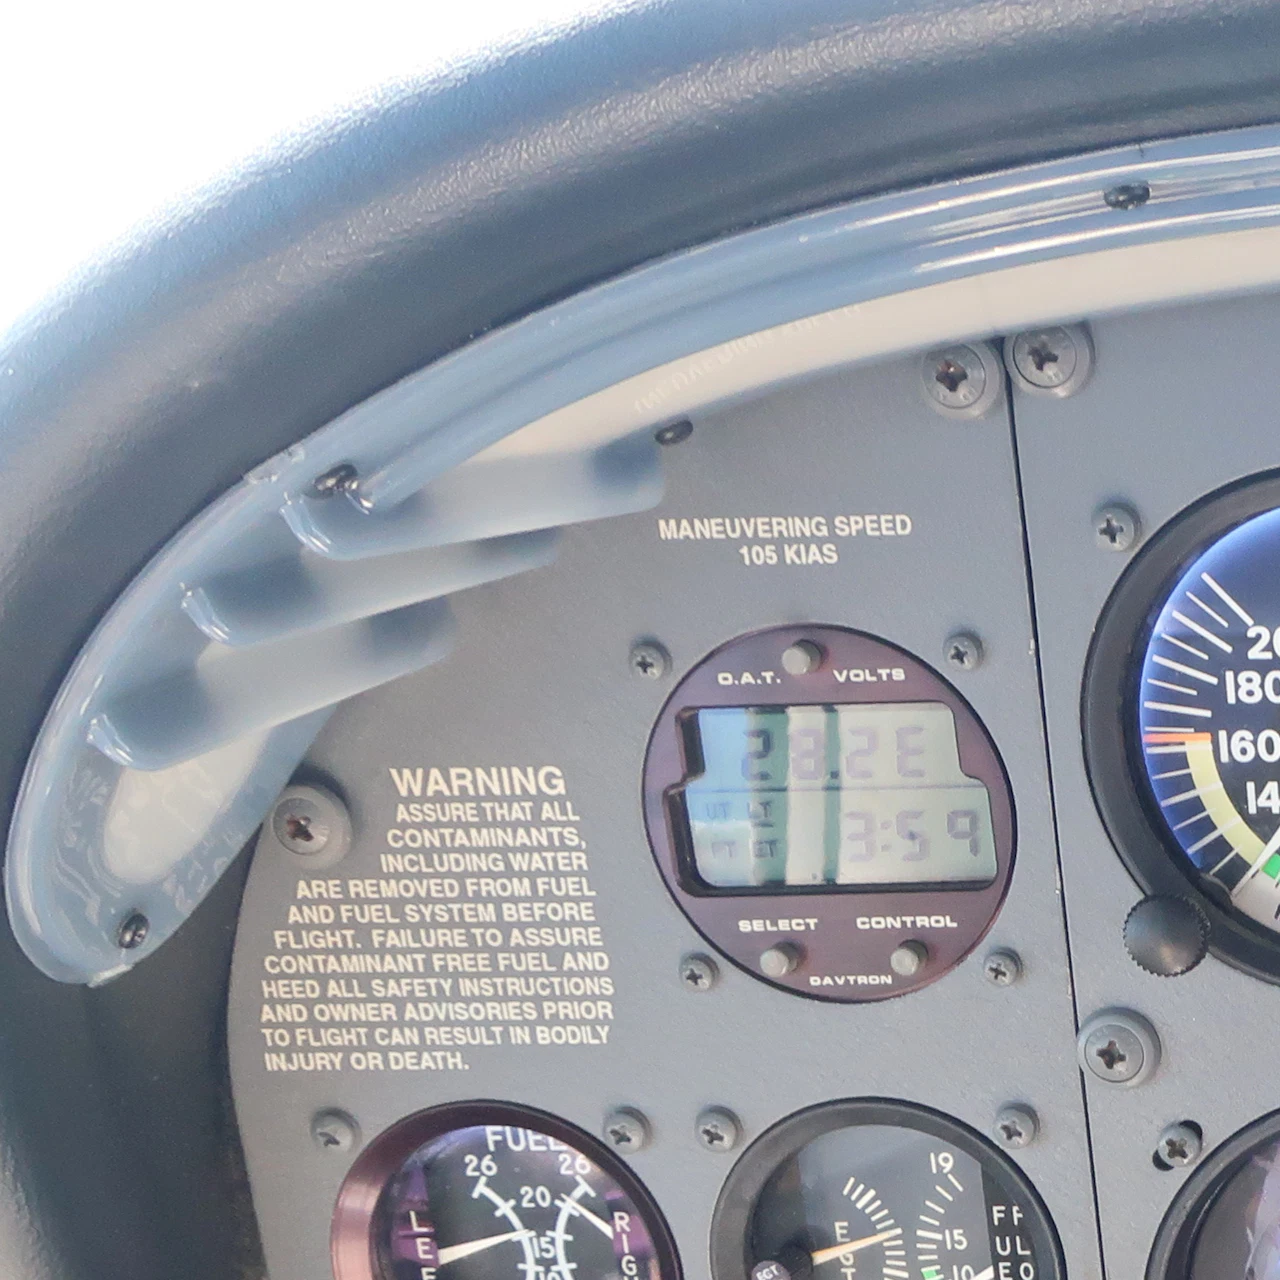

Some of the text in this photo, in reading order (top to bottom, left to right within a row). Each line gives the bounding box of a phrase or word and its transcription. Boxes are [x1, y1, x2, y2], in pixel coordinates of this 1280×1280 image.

[658, 514, 912, 540] MANEUVERING SPEED
[739, 543, 838, 566] 105 KIAS
[717, 667, 906, 686] O.A.T. VOLTS
[389, 765, 566, 797] WARNING
[396, 800, 581, 822] ASSURE THAT ALL
[387, 826, 587, 850] CONTAMINANTS,
[380, 851, 589, 874] INCLUDING WATER
[296, 876, 597, 899] ARE REMOVED FROM FUEL
[738, 915, 958, 933] SELECT CONTROL
[264, 1050, 470, 1071] INJURY OR DEATH.
